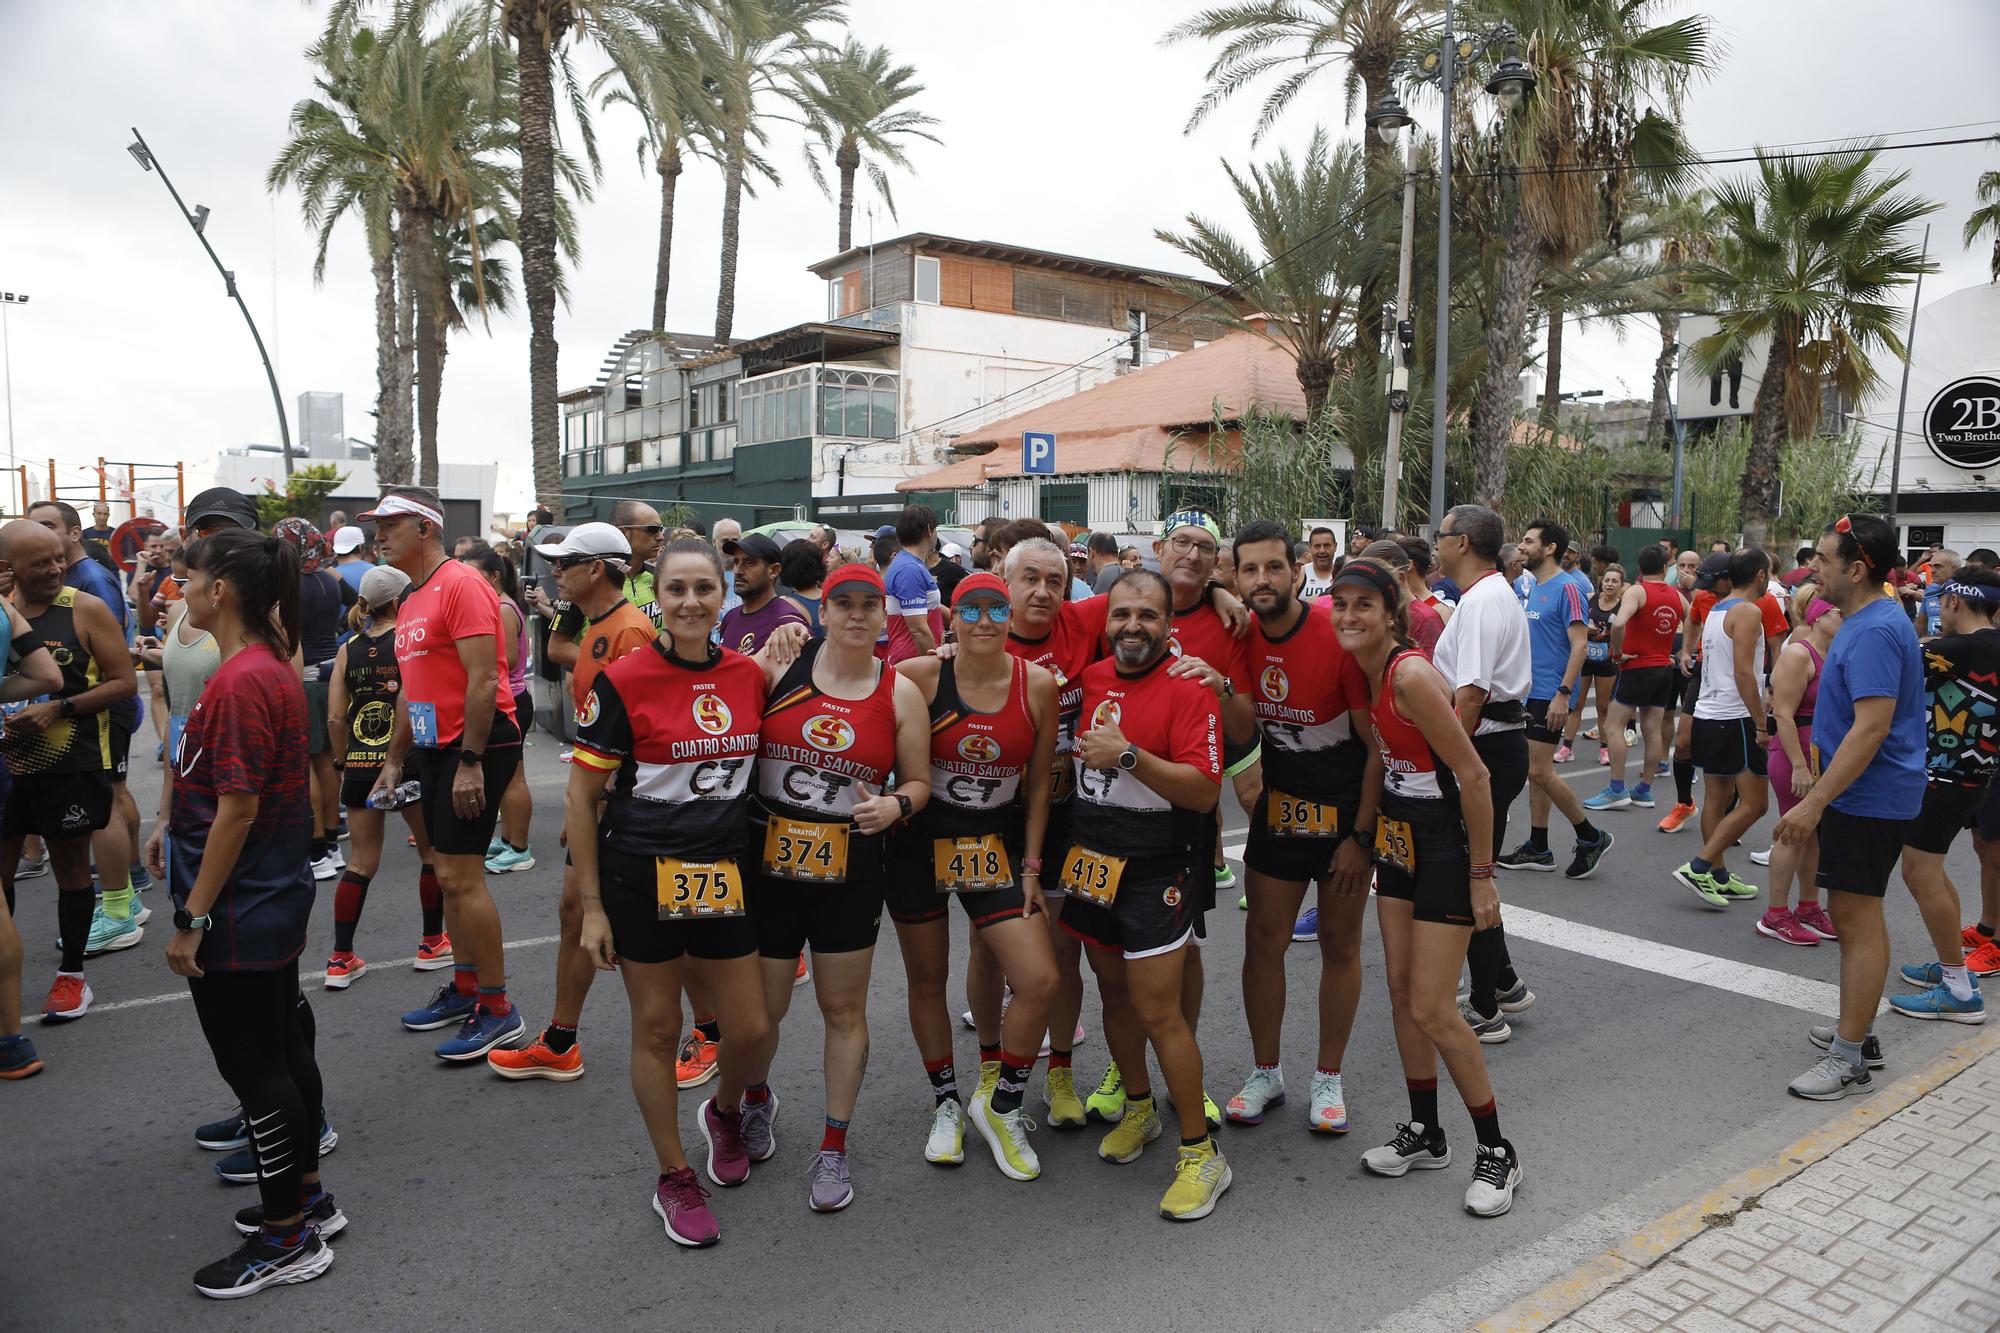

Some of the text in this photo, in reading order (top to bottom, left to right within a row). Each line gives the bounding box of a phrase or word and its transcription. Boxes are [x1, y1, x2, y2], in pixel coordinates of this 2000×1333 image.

[1936, 432, 1961, 442] Two
[1031, 437, 1049, 468] P
[821, 702, 852, 714] FASTER
[1278, 705, 1316, 724] SANTOS
[967, 723, 994, 731] FASTER
[672, 733, 759, 759] CUATRO SANTOS
[766, 742, 879, 781] CUATRO SANTOS
[935, 758, 1018, 777] CUATRO SANTOS
[1280, 800, 1323, 824] 361
[776, 835, 833, 867] 374
[948, 851, 999, 877] 418
[1071, 857, 1109, 889] 413
[673, 872, 729, 902] 375
